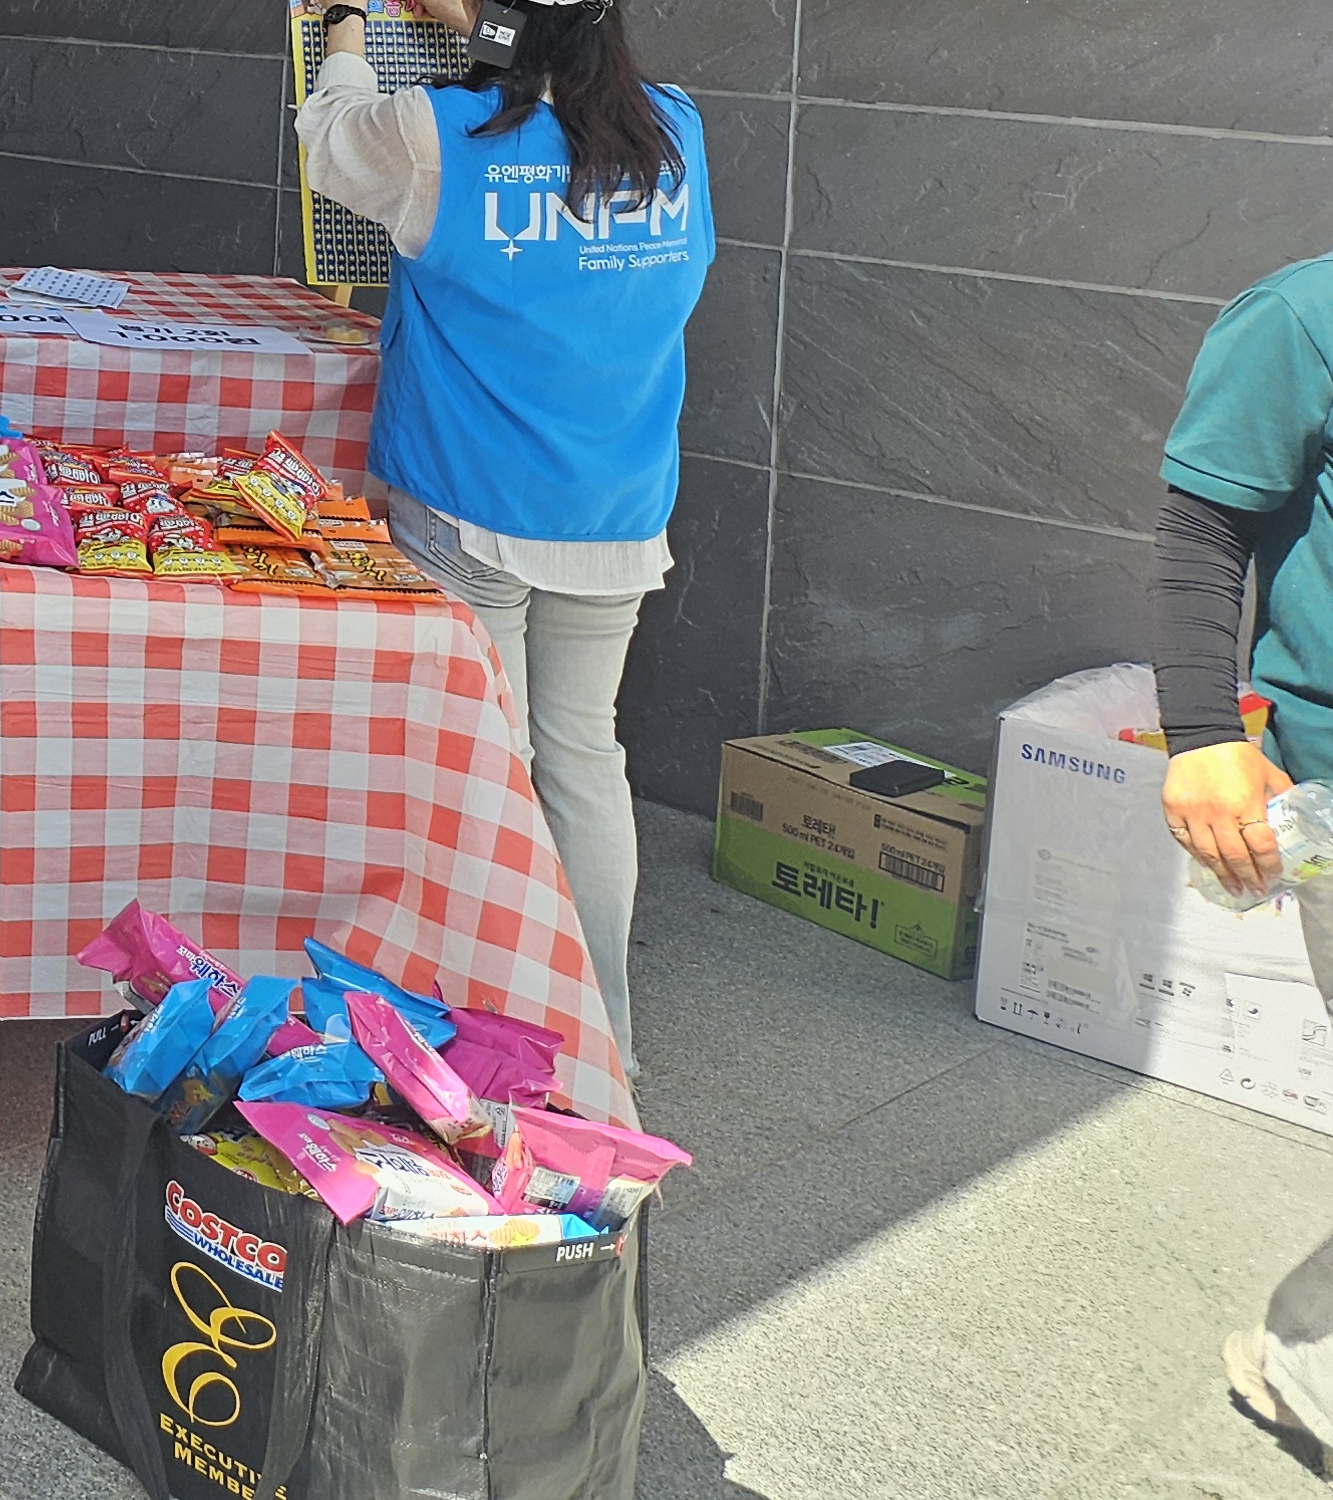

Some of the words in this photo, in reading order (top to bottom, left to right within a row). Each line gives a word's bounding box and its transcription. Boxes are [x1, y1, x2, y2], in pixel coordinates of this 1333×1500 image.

[578, 256, 625, 271] Family
[628, 249, 689, 269] Supporters
[579, 244, 605, 254] United
[606, 243, 638, 253] Nations
[1020, 743, 1126, 784] SAMSUNG
[810, 834, 826, 848] PET
[772, 861, 879, 930] 토레타!
[192, 957, 238, 998] 웨하스
[88, 1026, 107, 1047] PULL
[166, 1181, 287, 1273] COSTCO
[193, 1231, 284, 1290] WHOLESALE
[556, 1242, 594, 1262] PUSH
[160, 1413, 287, 1500] EXECUTIE
